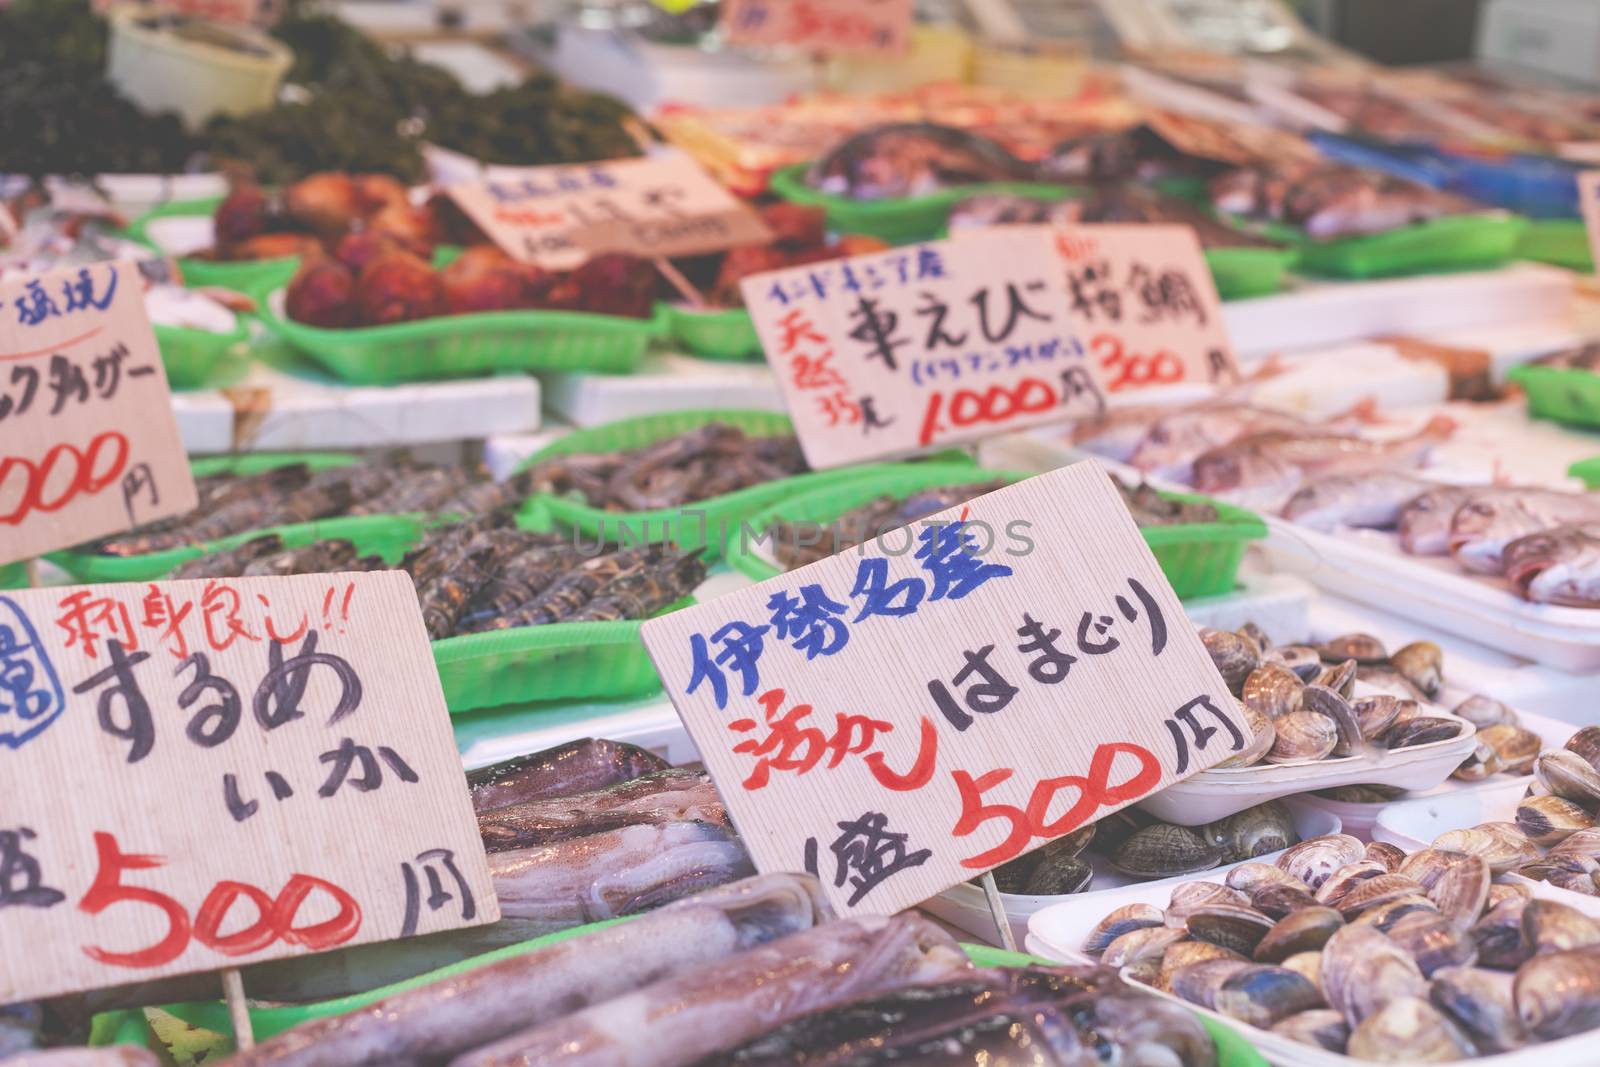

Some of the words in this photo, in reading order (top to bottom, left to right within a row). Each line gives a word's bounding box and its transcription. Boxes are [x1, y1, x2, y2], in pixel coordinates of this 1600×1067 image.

[847, 280, 1053, 372] 車えび
[685, 520, 1014, 710] 伊勢名産
[927, 576, 1169, 732] はまぐり
[72, 629, 364, 764] するめ
[222, 737, 420, 823] いか
